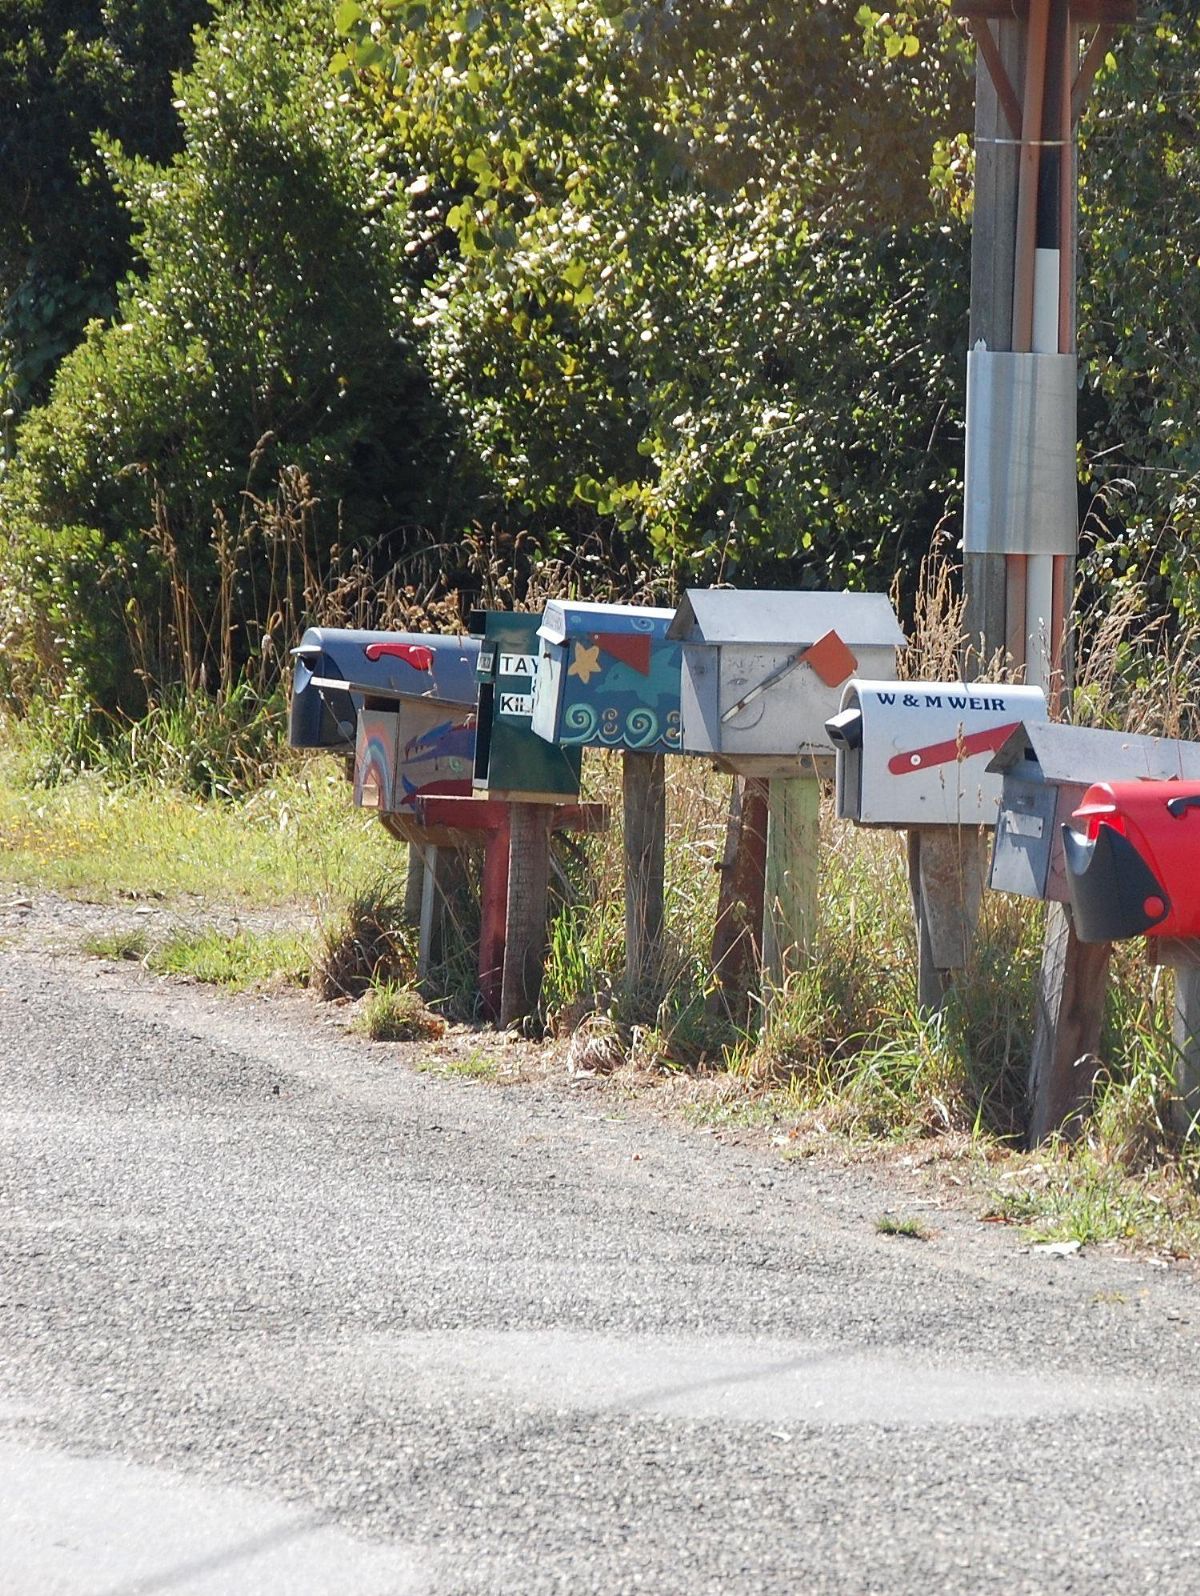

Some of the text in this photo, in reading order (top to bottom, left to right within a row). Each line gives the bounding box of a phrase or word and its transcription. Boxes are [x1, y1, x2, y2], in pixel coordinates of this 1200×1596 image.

[876, 692, 1006, 711] W & M WEIR
